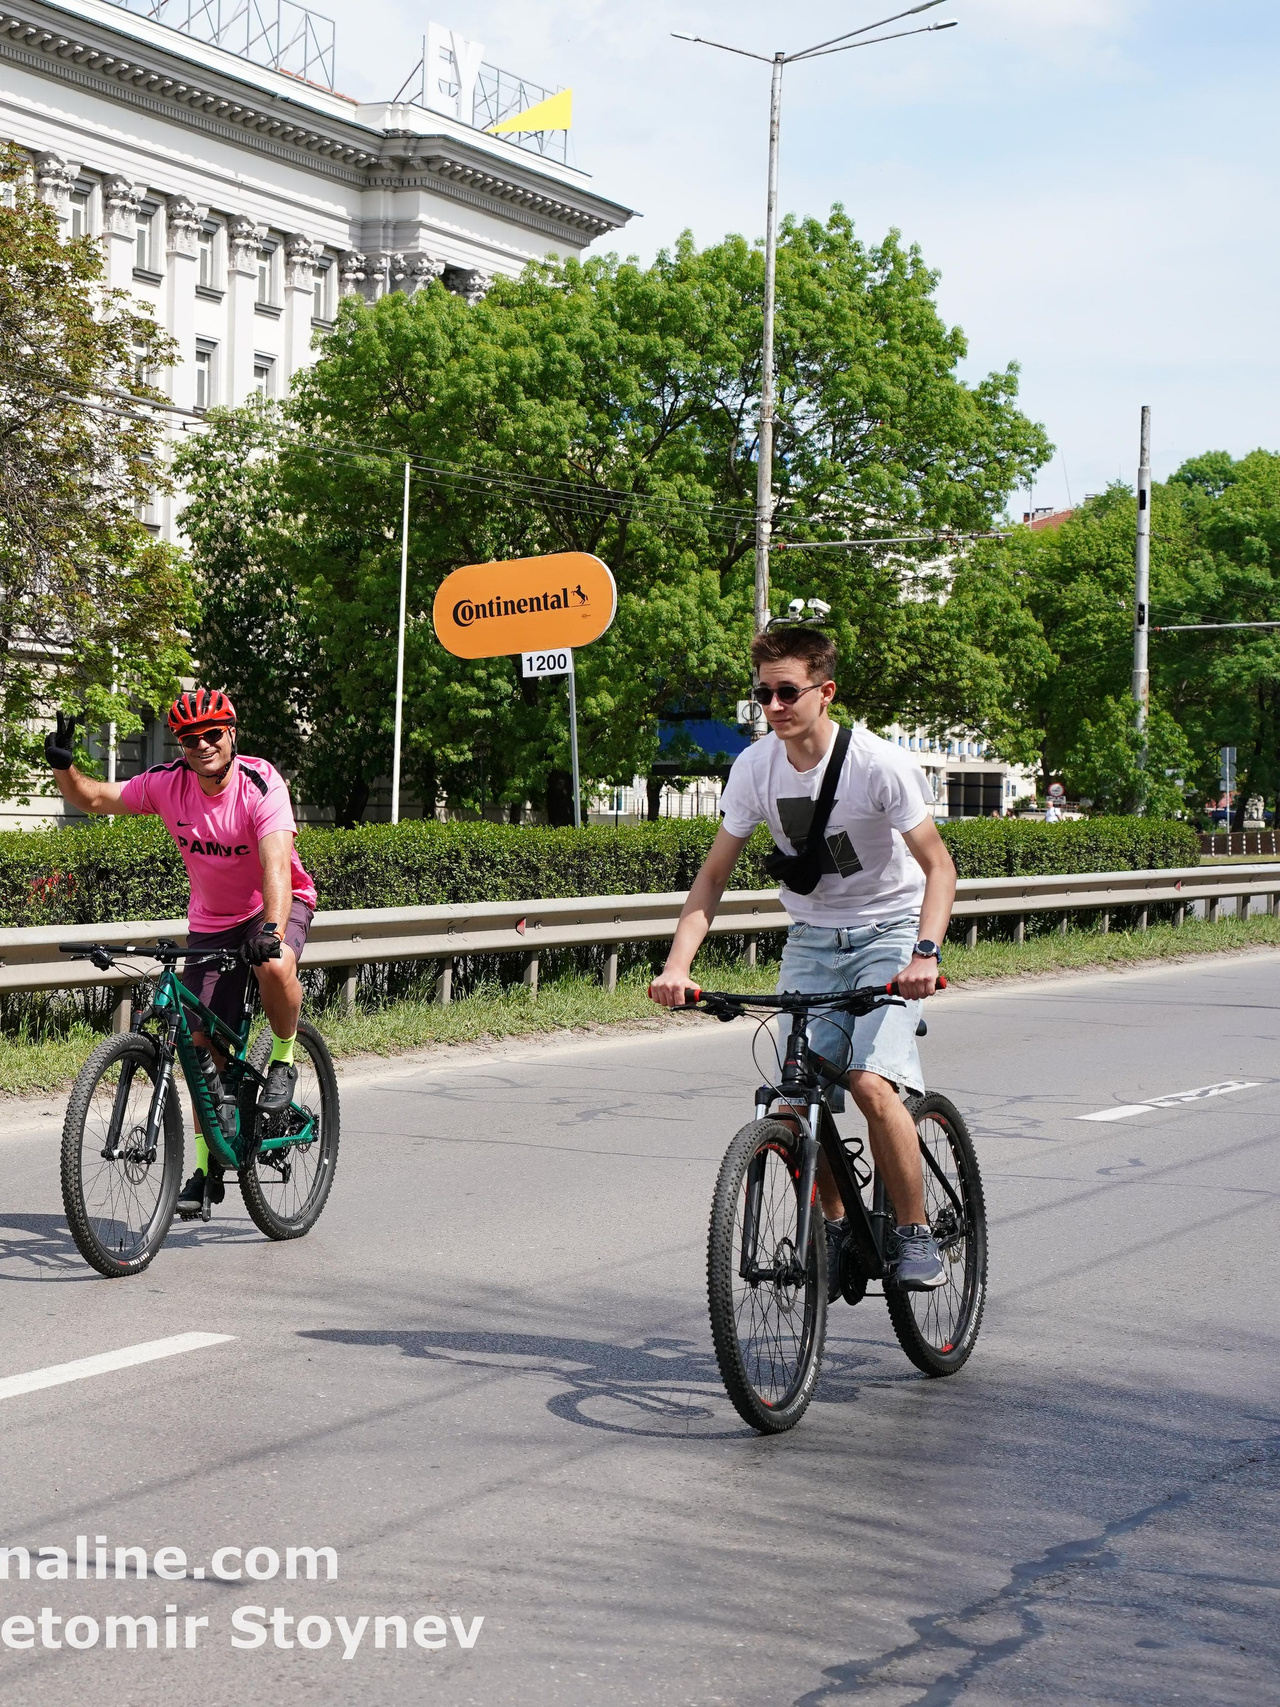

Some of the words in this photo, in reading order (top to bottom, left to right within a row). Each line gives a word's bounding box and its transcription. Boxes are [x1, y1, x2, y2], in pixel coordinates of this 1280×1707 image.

[424, 20, 485, 126] EY
[452, 588, 570, 627] Continental
[526, 653, 567, 672] 1200
